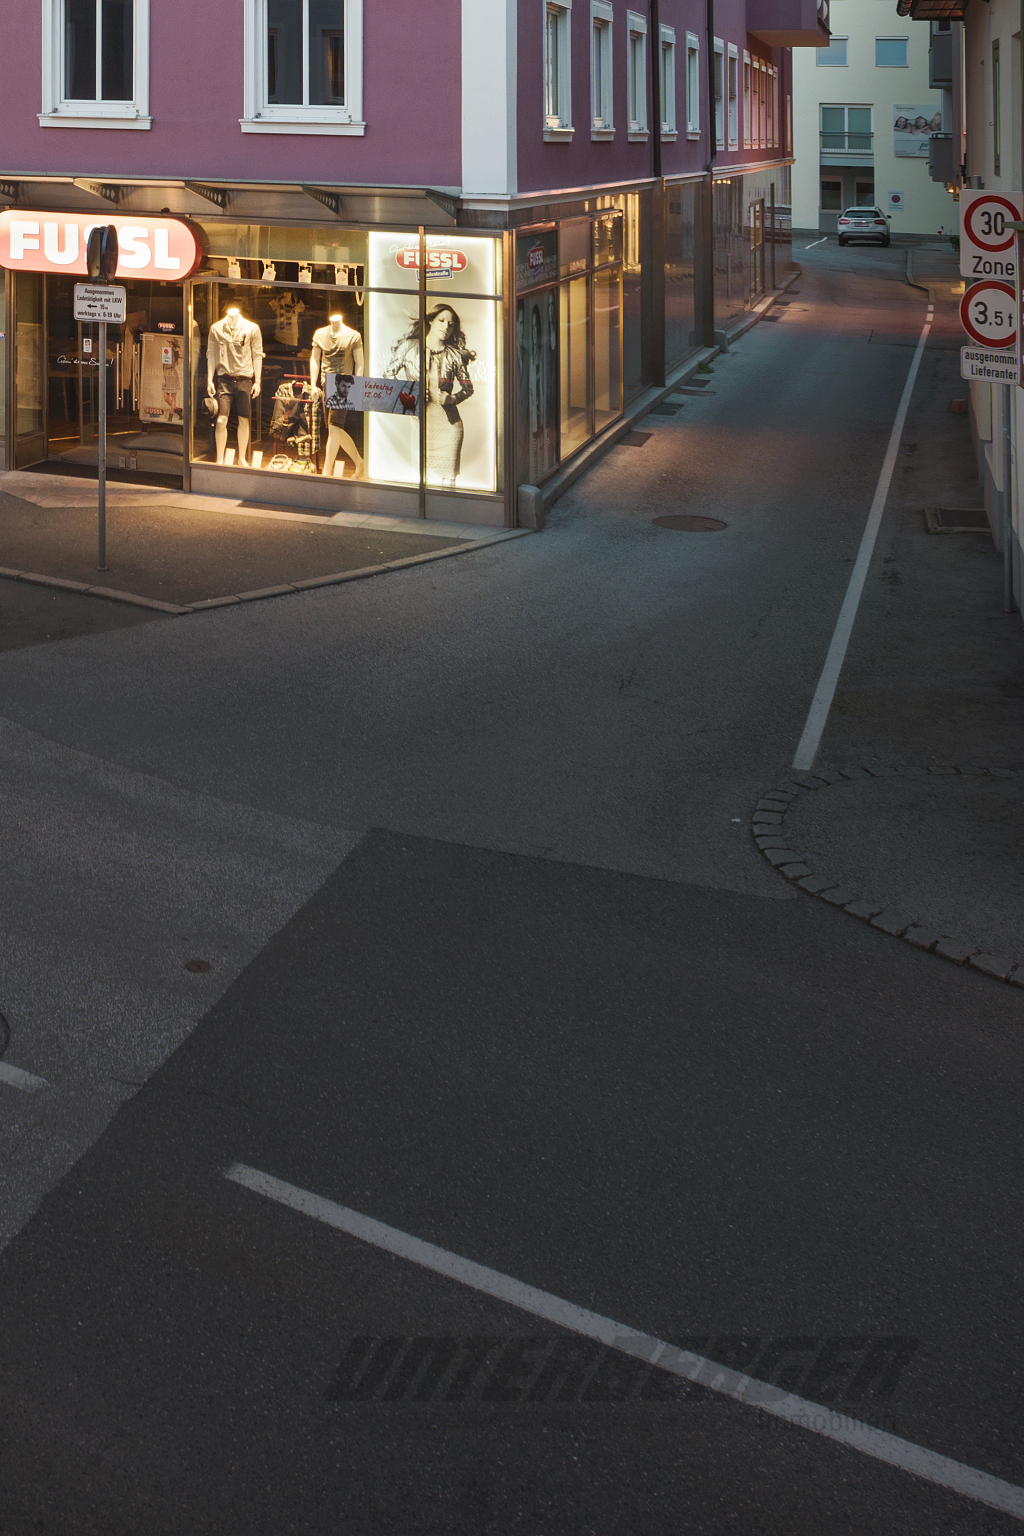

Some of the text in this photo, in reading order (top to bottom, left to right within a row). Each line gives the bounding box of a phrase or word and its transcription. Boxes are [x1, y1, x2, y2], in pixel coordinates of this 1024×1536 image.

[980, 211, 1005, 236] 30
[9, 220, 181, 270] FUSL
[972, 255, 1015, 276] Zone
[84, 287, 115, 296] Ausgenommen
[364, 380, 394, 396] Vatertag
